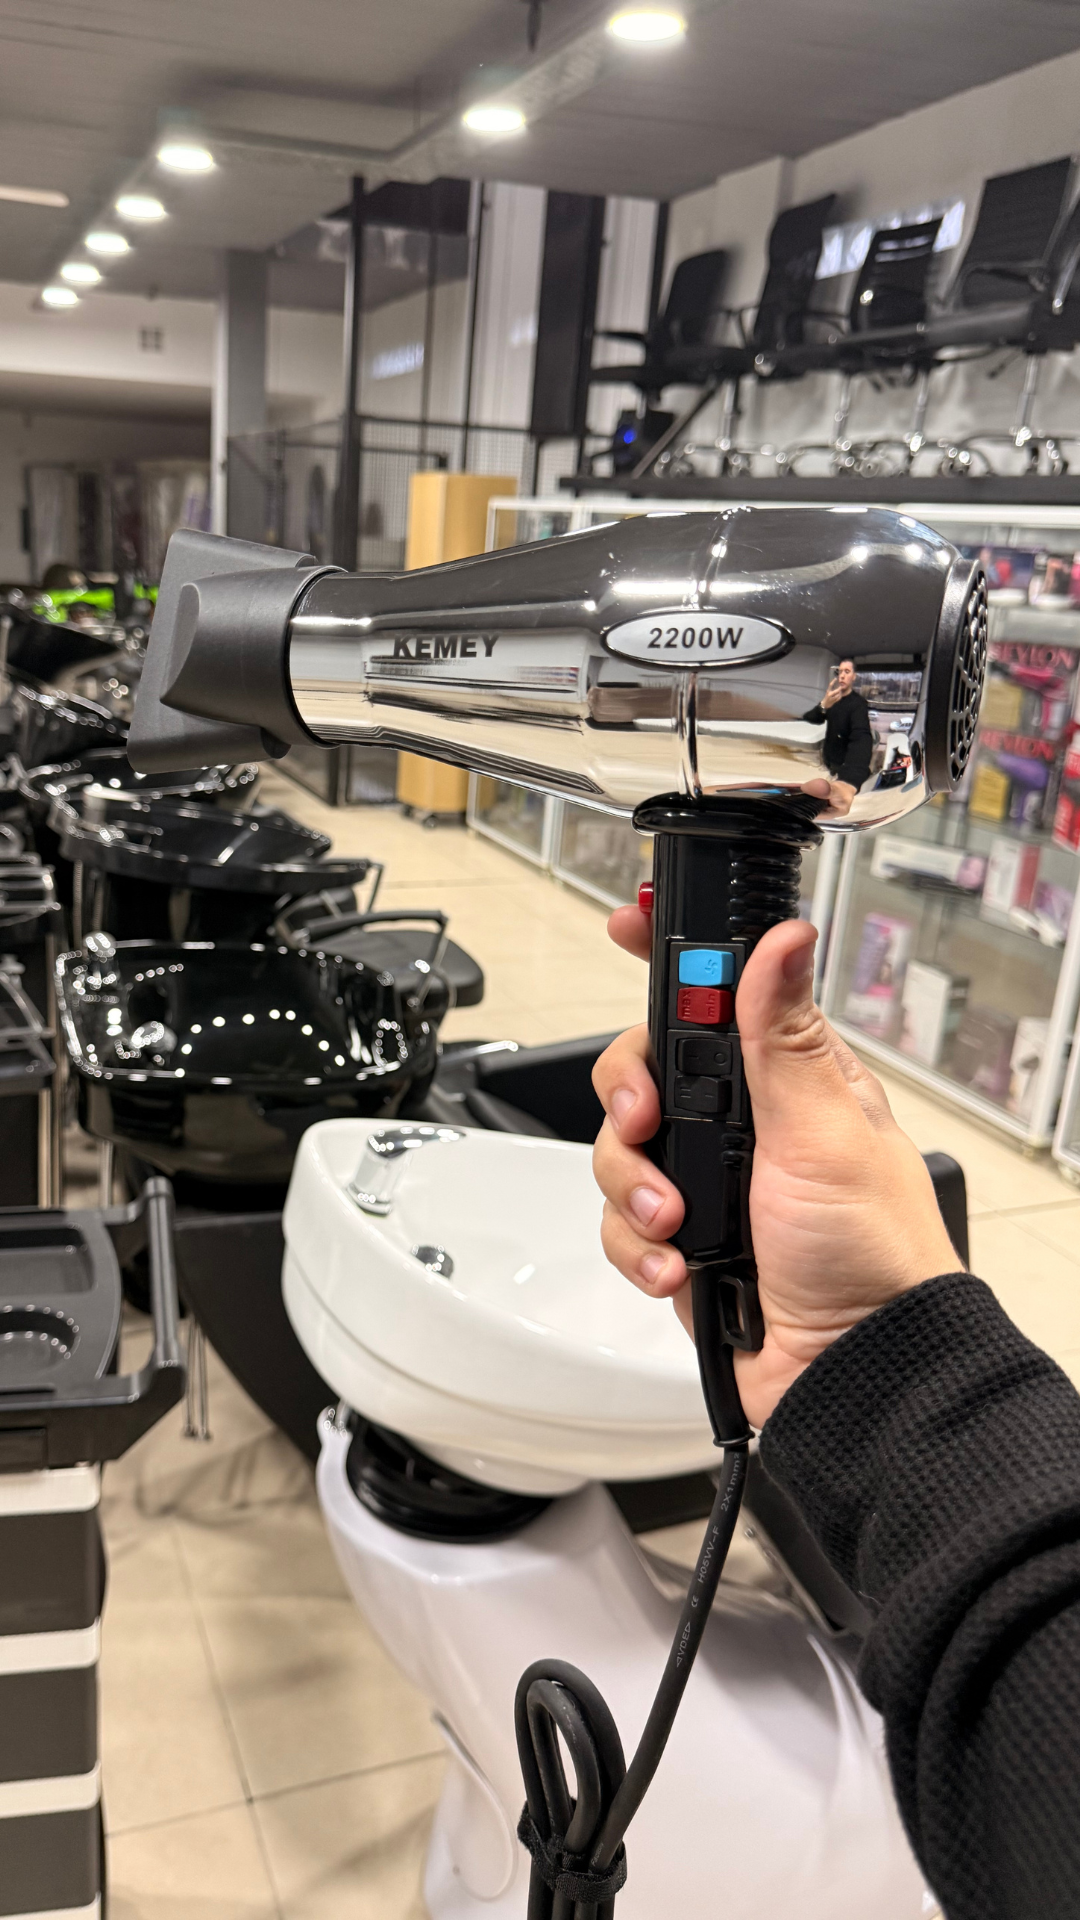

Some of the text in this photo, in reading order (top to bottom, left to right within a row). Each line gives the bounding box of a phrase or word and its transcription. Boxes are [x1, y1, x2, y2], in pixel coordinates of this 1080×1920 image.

[393, 632, 500, 659] KEMEY
[647, 627, 744, 649] 2200W
[682, 990, 691, 1019] max
[705, 993, 716, 1019] min
[698, 1525, 720, 1584] H05VV-F
